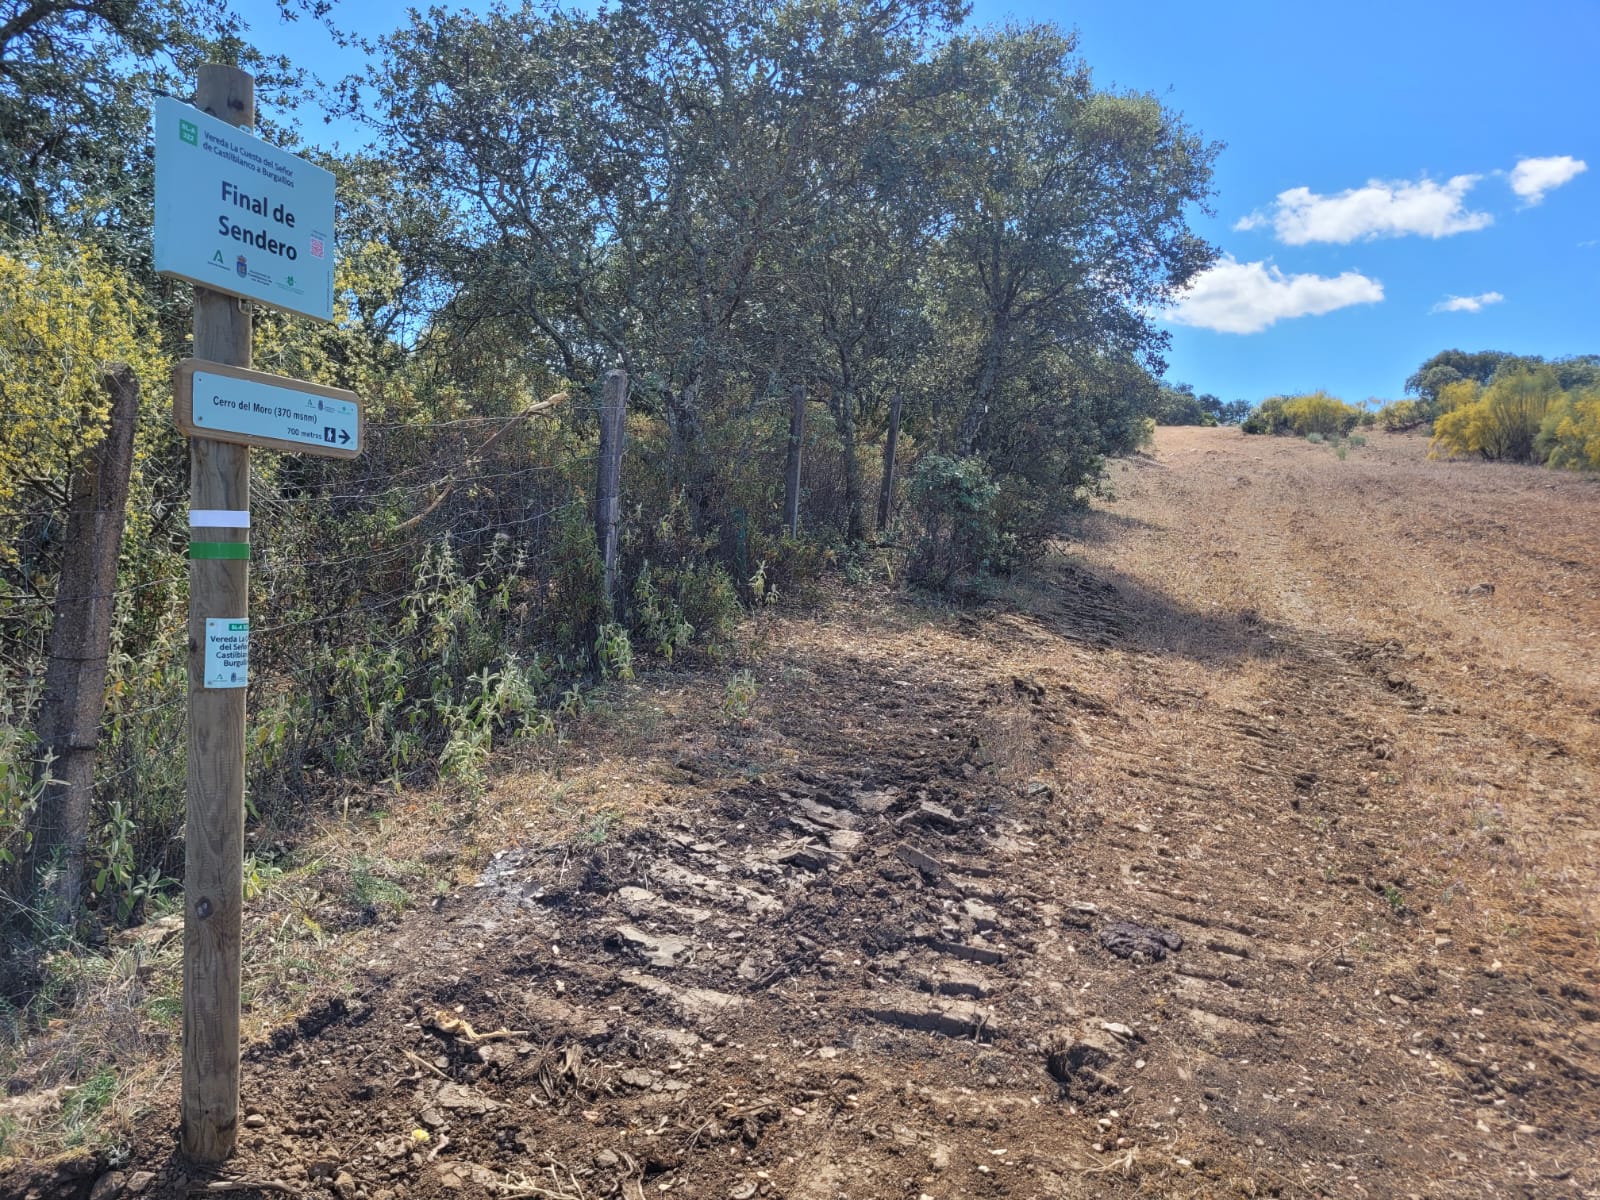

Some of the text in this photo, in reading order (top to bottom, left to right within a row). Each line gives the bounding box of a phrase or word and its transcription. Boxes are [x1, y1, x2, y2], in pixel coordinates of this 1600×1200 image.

[203, 142, 212, 152] de
[214, 146, 256, 171] Castilblanco
[262, 168, 294, 188] Burguillos
[204, 129, 294, 177] Vereda La Cuesta del Señor
[222, 180, 295, 228] Final de
[218, 215, 297, 260] Sendero
[213, 395, 318, 424] Cerro del Moro (370 msnm)
[287, 427, 322, 440] 700 metros
[210, 635, 238, 643] Vereda
[219, 643, 248, 651] del Seño
